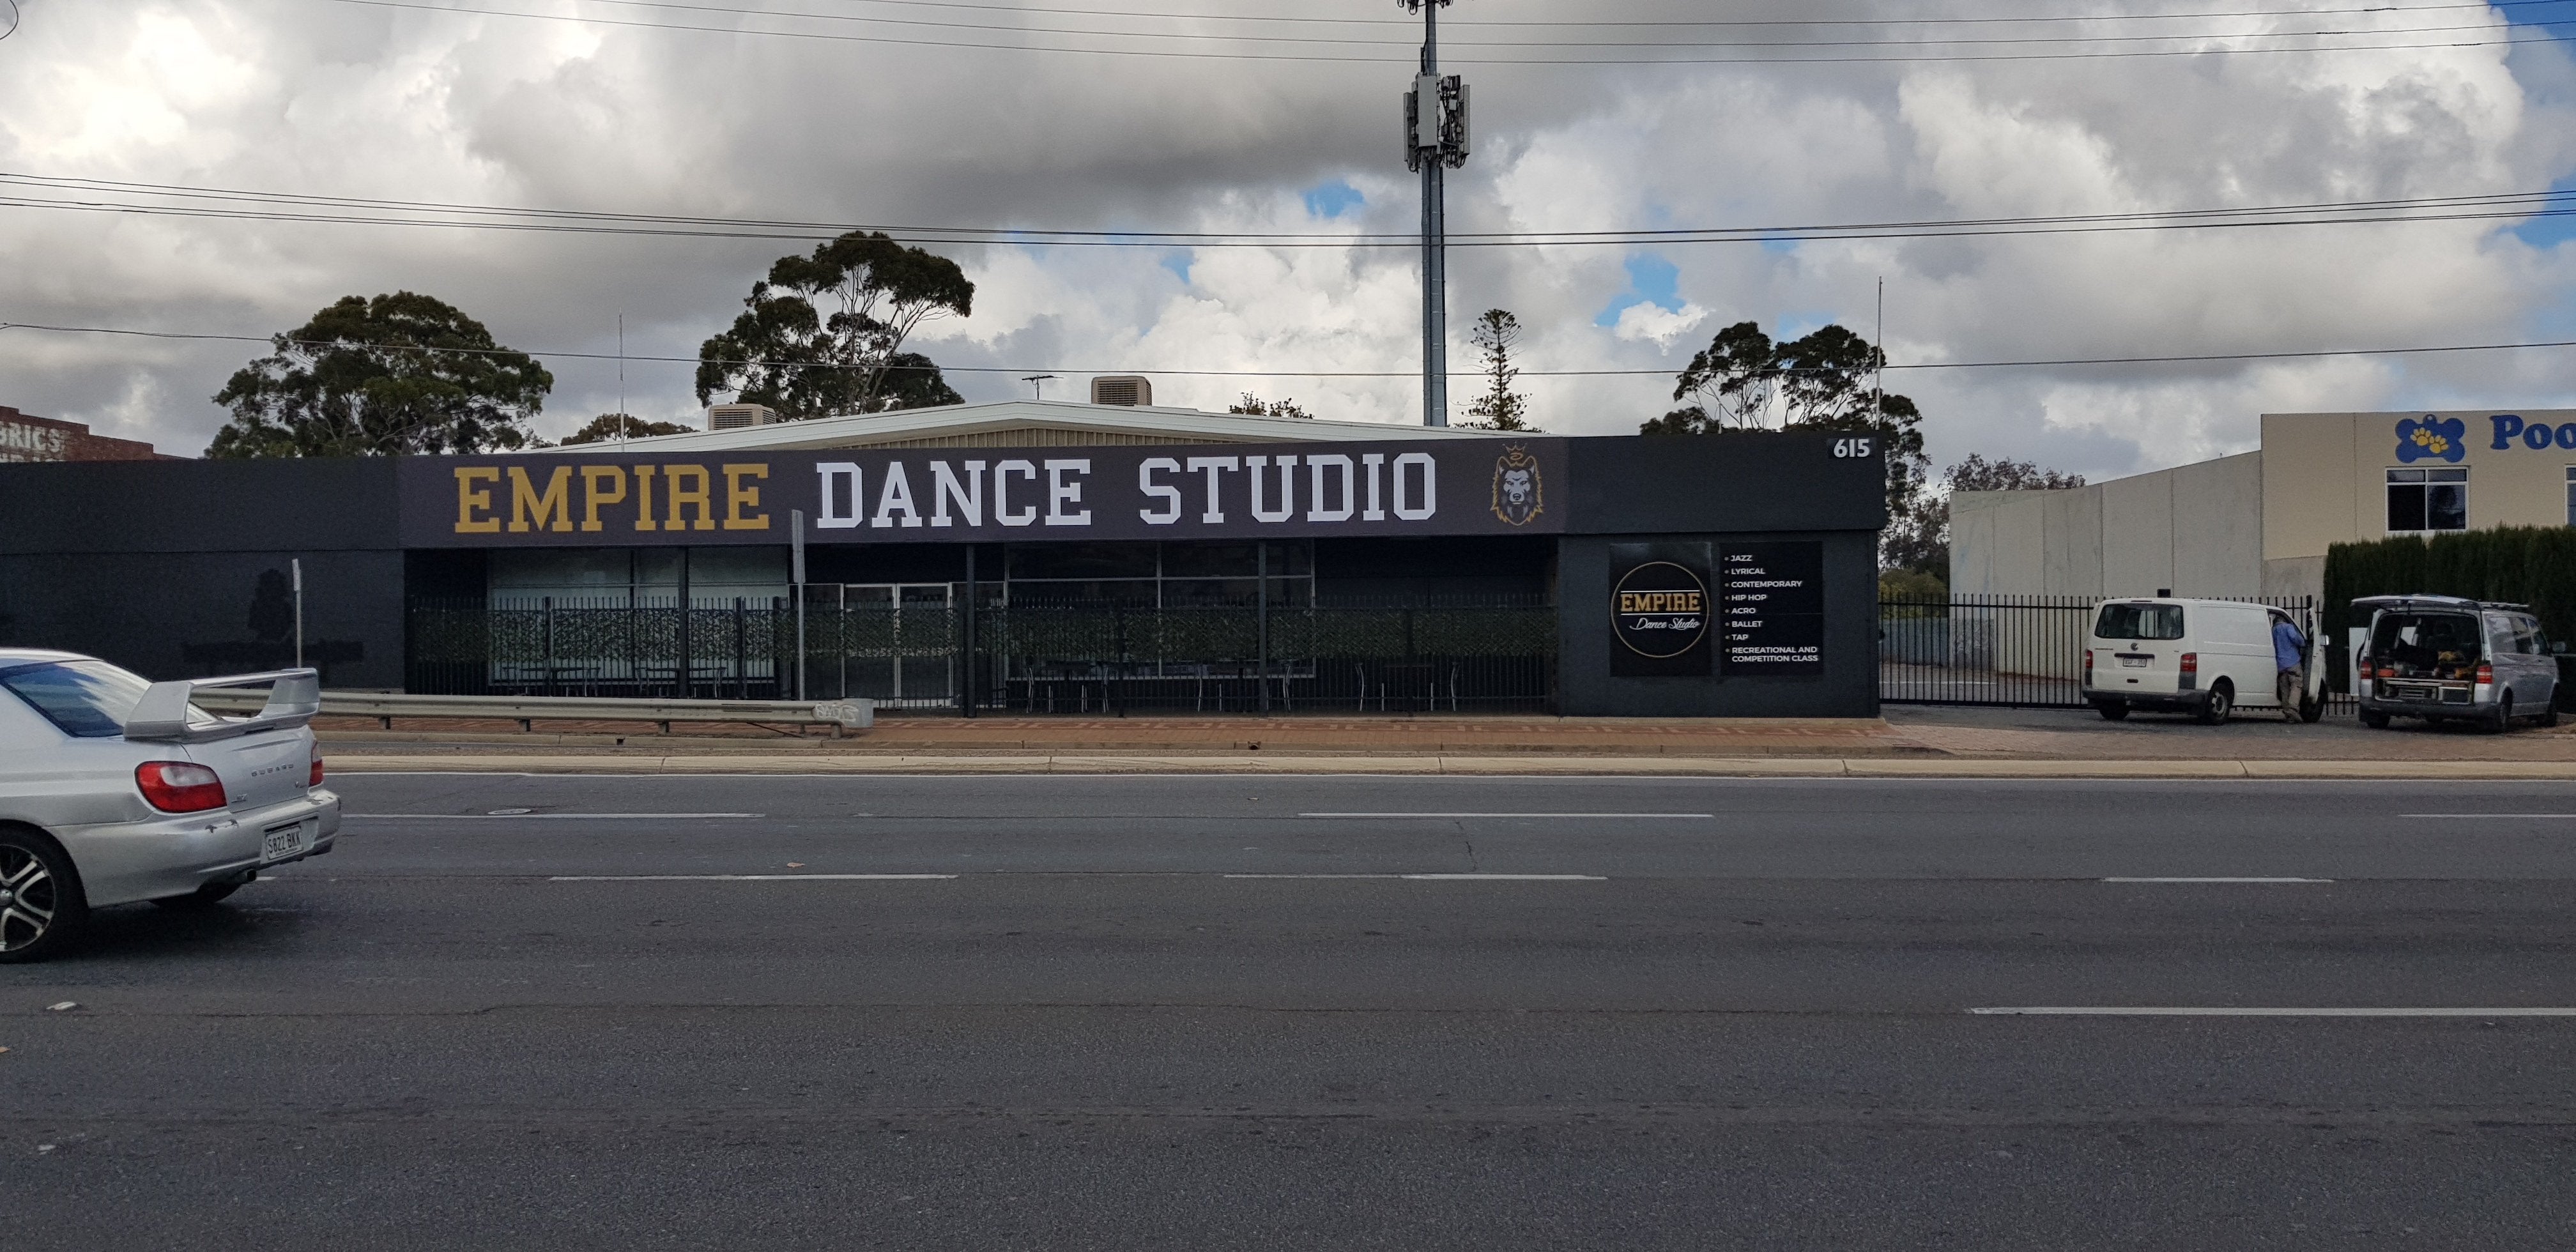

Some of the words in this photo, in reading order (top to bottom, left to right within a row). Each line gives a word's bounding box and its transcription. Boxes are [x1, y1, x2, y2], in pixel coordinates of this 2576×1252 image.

[2489, 415, 2576, 450] Poo
[1834, 438, 1870, 458] 615
[454, 463, 769, 533] EMPIRE
[816, 459, 1091, 528] DANCE
[1139, 452, 1436, 524] STUDIO
[1731, 580, 1803, 588] CONTEMPORARY
[1620, 592, 1701, 613] EMPIRE
[1629, 617, 1667, 630] Dance
[1668, 617, 1701, 631] Studio
